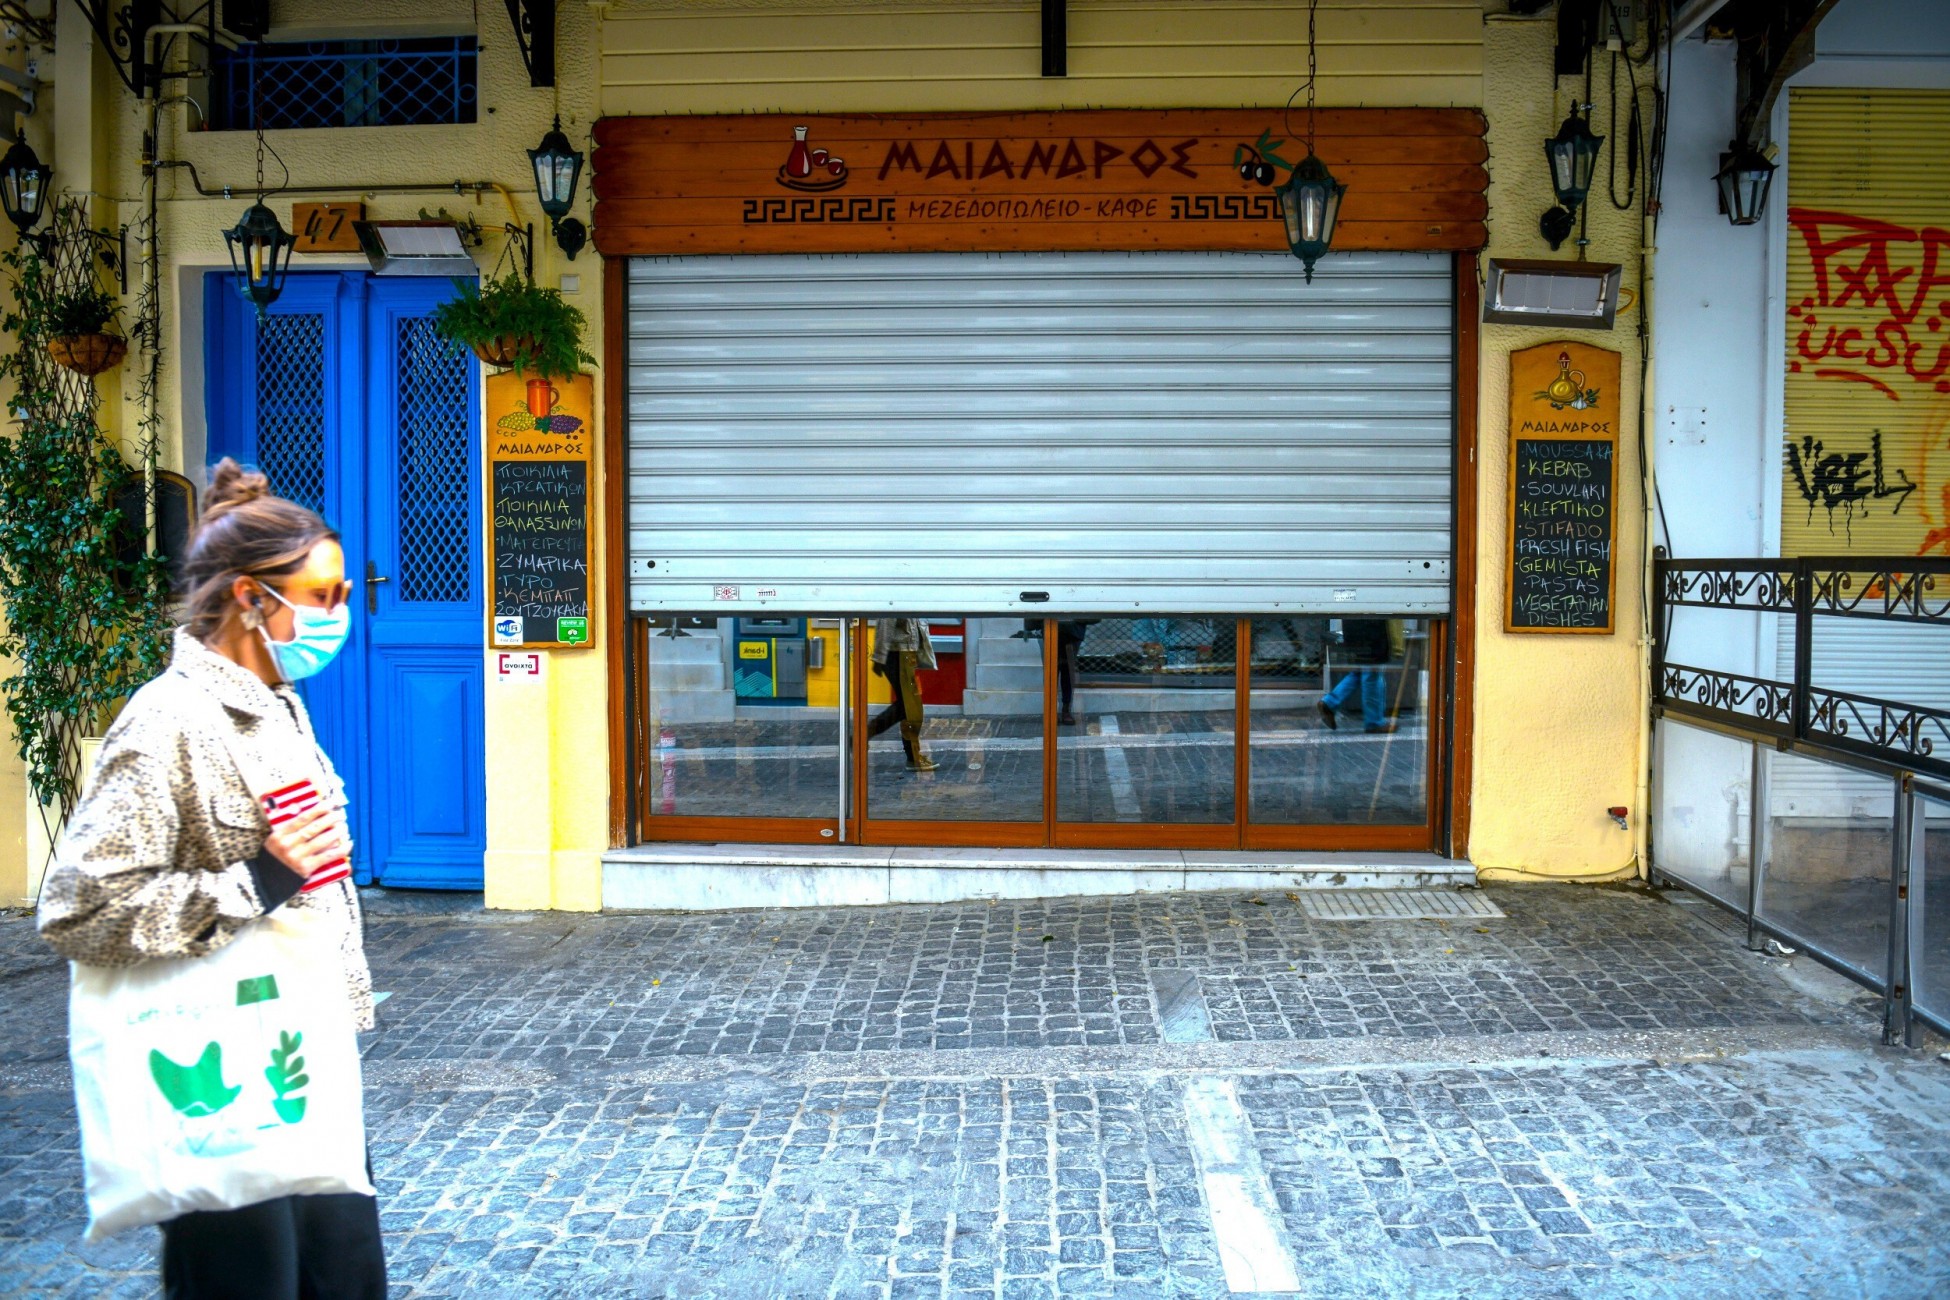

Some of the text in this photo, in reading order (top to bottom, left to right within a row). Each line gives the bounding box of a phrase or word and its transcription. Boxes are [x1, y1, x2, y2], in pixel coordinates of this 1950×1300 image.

[877, 137, 1199, 181] ΜΑΙΑΝΔΡΟΣ
[304, 208, 348, 245] 47
[1520, 421, 1611, 434] ΜΑΙΑΝΔΡΟΣ
[496, 442, 584, 455] ΜΑΙΑΝΔΡΟΣ
[1525, 442, 1613, 463] MOUSSAKA
[498, 463, 573, 480] ΠΟΙΚΙΛΙΑ
[1529, 459, 1592, 479] KEBAB
[500, 480, 586, 498] ΚΡΕΑΤΙΚΩΝ
[1527, 481, 1605, 501] SOUVLAKI
[497, 497, 570, 515] ΠΟΙΚΙΛΙΑ
[1522, 500, 1605, 519] KLEFTIKO
[494, 513, 586, 533] ΘΑΛΑΣΣΙΝΩΝ
[1524, 520, 1602, 540] STIFADO
[1519, 538, 1612, 562] FRESH FISH
[499, 553, 588, 576] ΖΥΜΑΡΙΚΑ
[1518, 556, 1602, 579] GEMISTA
[502, 573, 553, 590] ΓΥΡΟ
[1525, 574, 1600, 595] PASTAS
[503, 587, 580, 604] ΚΕΜΠΑΠ
[1519, 593, 1610, 614] VEGETARIAN
[1526, 611, 1596, 627] DISHES
